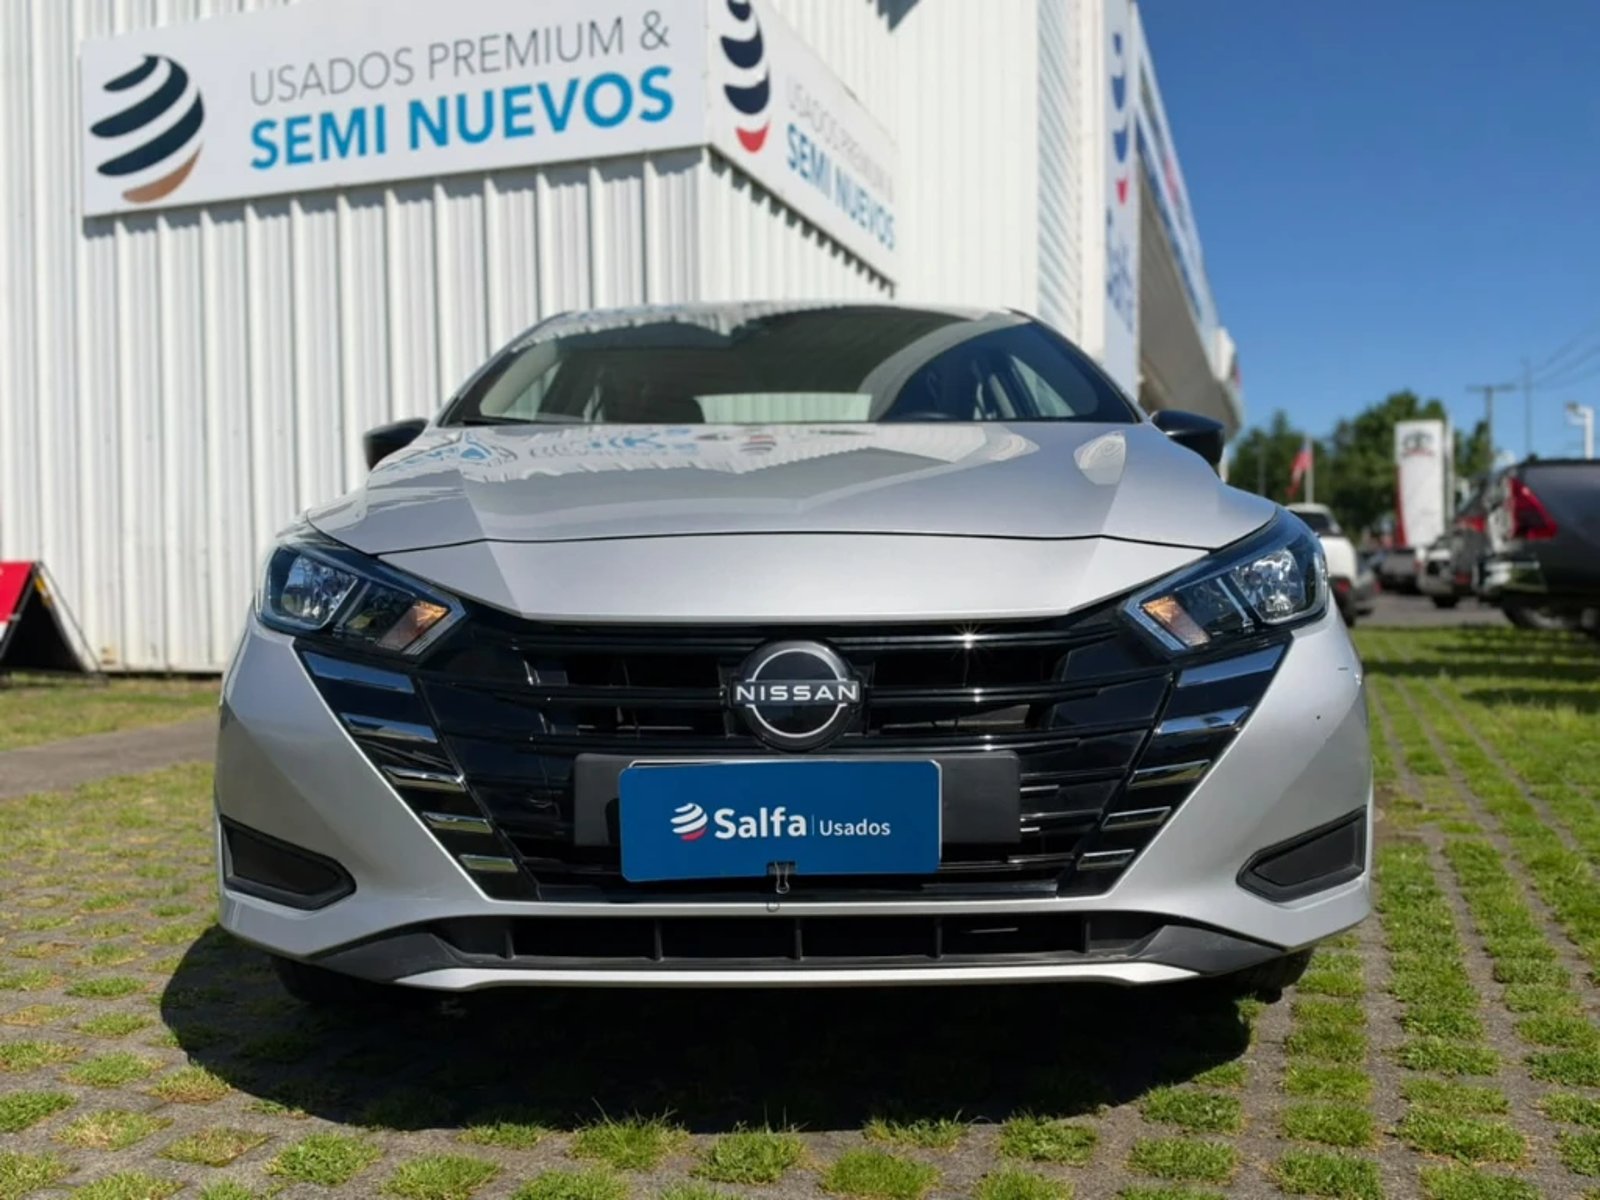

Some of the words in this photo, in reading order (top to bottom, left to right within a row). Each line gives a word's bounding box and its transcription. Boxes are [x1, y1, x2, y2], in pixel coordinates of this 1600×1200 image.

[250, 48, 414, 106] USADOS
[428, 16, 624, 80] PREMIUM
[640, 10, 670, 51] &
[250, 105, 387, 170] SEMI
[408, 65, 674, 151] NUEVOS
[787, 122, 832, 199] SEMI
[736, 685, 858, 700] NISSAN
[714, 806, 807, 840] Salfa
[819, 819, 891, 837] Usados
